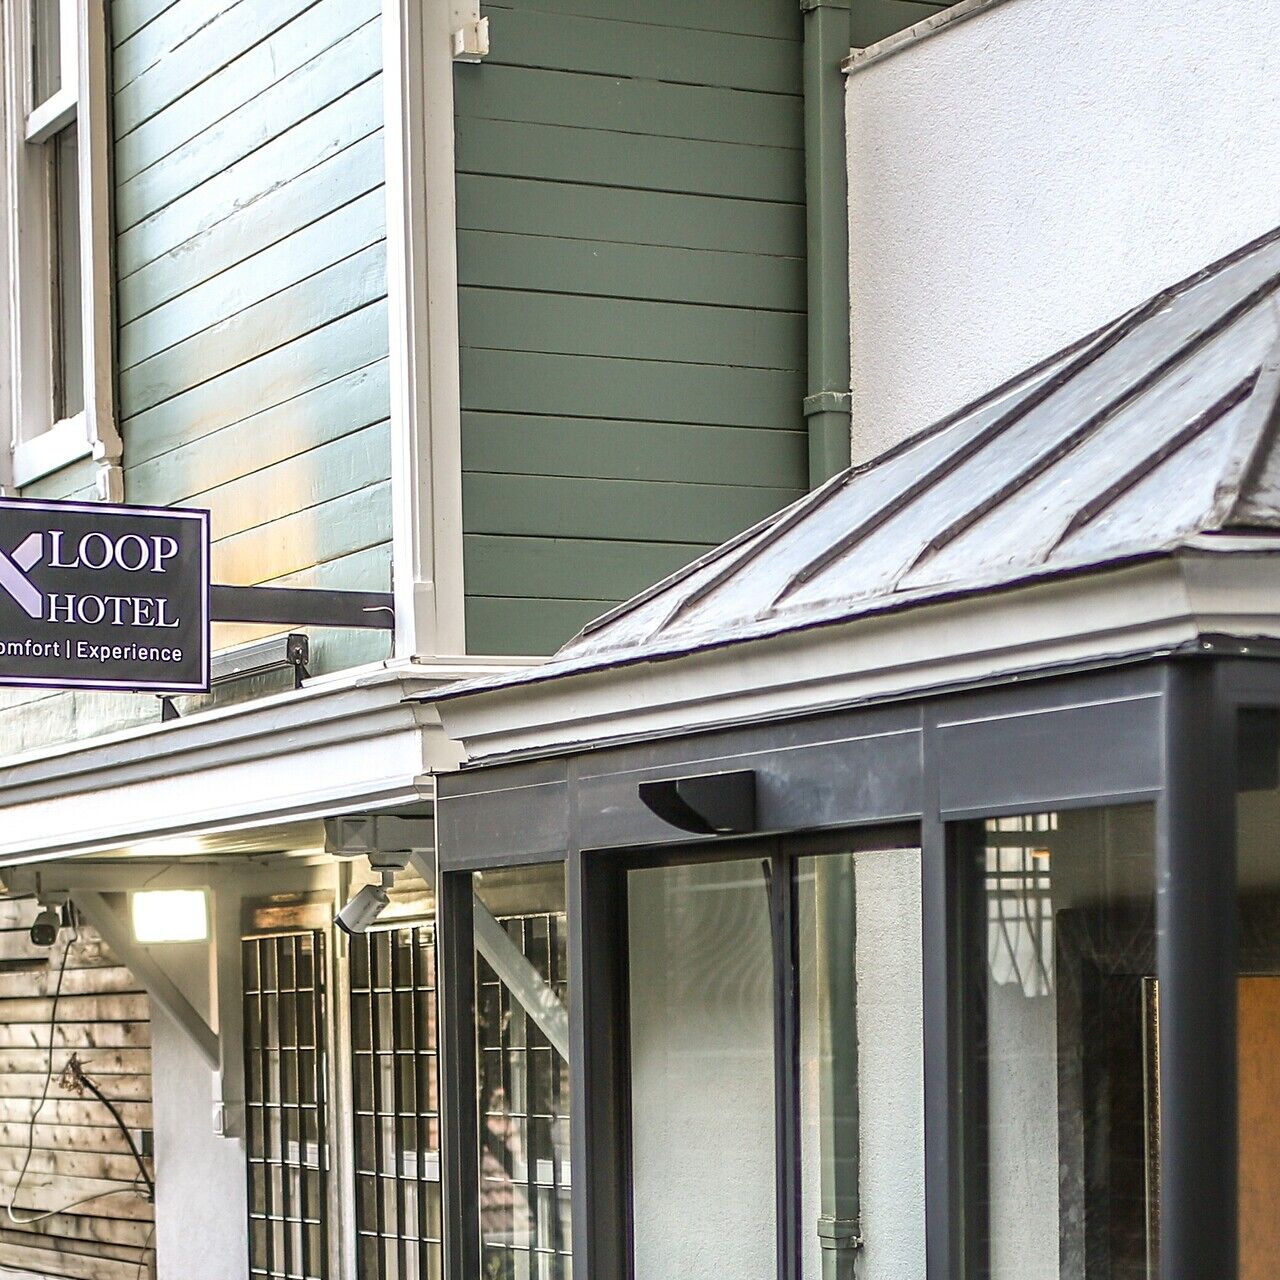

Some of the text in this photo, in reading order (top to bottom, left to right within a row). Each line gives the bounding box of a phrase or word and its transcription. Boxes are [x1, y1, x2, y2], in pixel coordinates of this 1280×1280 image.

[47, 530, 179, 573] LOOP
[47, 593, 180, 628] HOTEL
[77, 642, 183, 662] Experience
